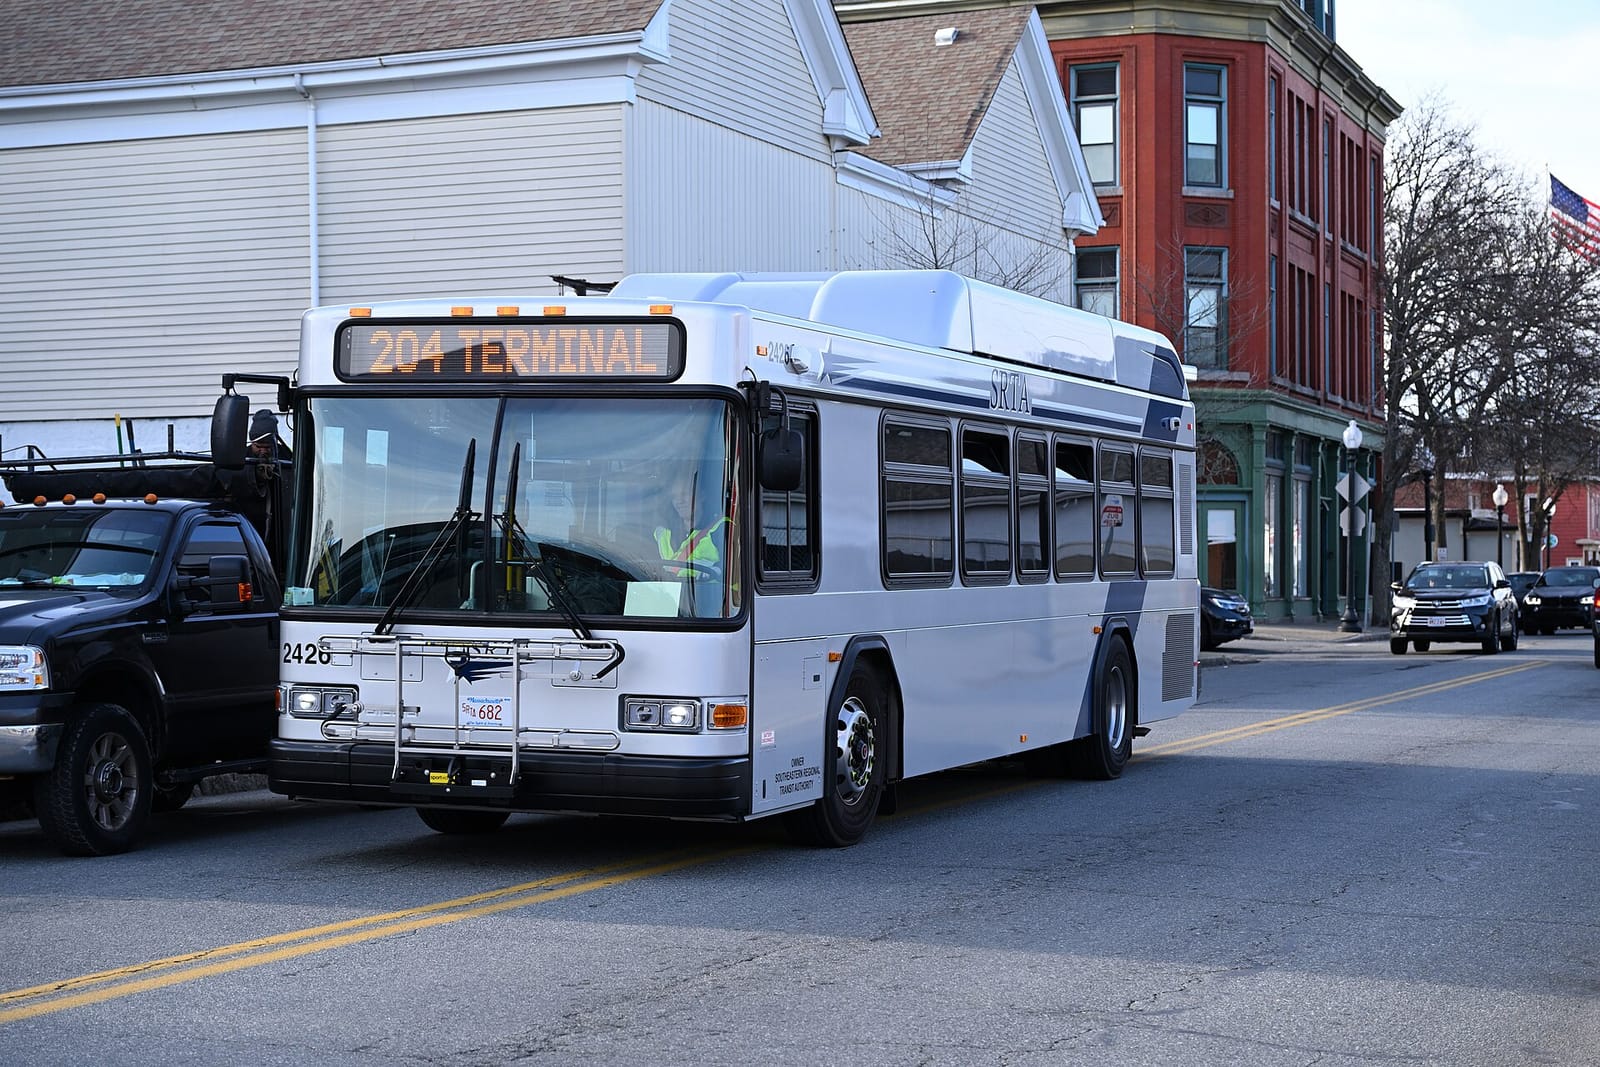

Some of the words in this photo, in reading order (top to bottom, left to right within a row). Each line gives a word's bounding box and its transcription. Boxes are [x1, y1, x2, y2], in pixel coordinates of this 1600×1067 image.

[369, 329, 445, 374] 204
[457, 328, 657, 374] TERMINAL
[990, 368, 1030, 413] SRTA
[283, 642, 331, 665] 2426
[478, 704, 502, 721] 682
[775, 770, 802, 783] SOUTHEASTERN
[780, 784, 795, 794] TRANSIT
[795, 780, 813, 791] AUTHORITY
